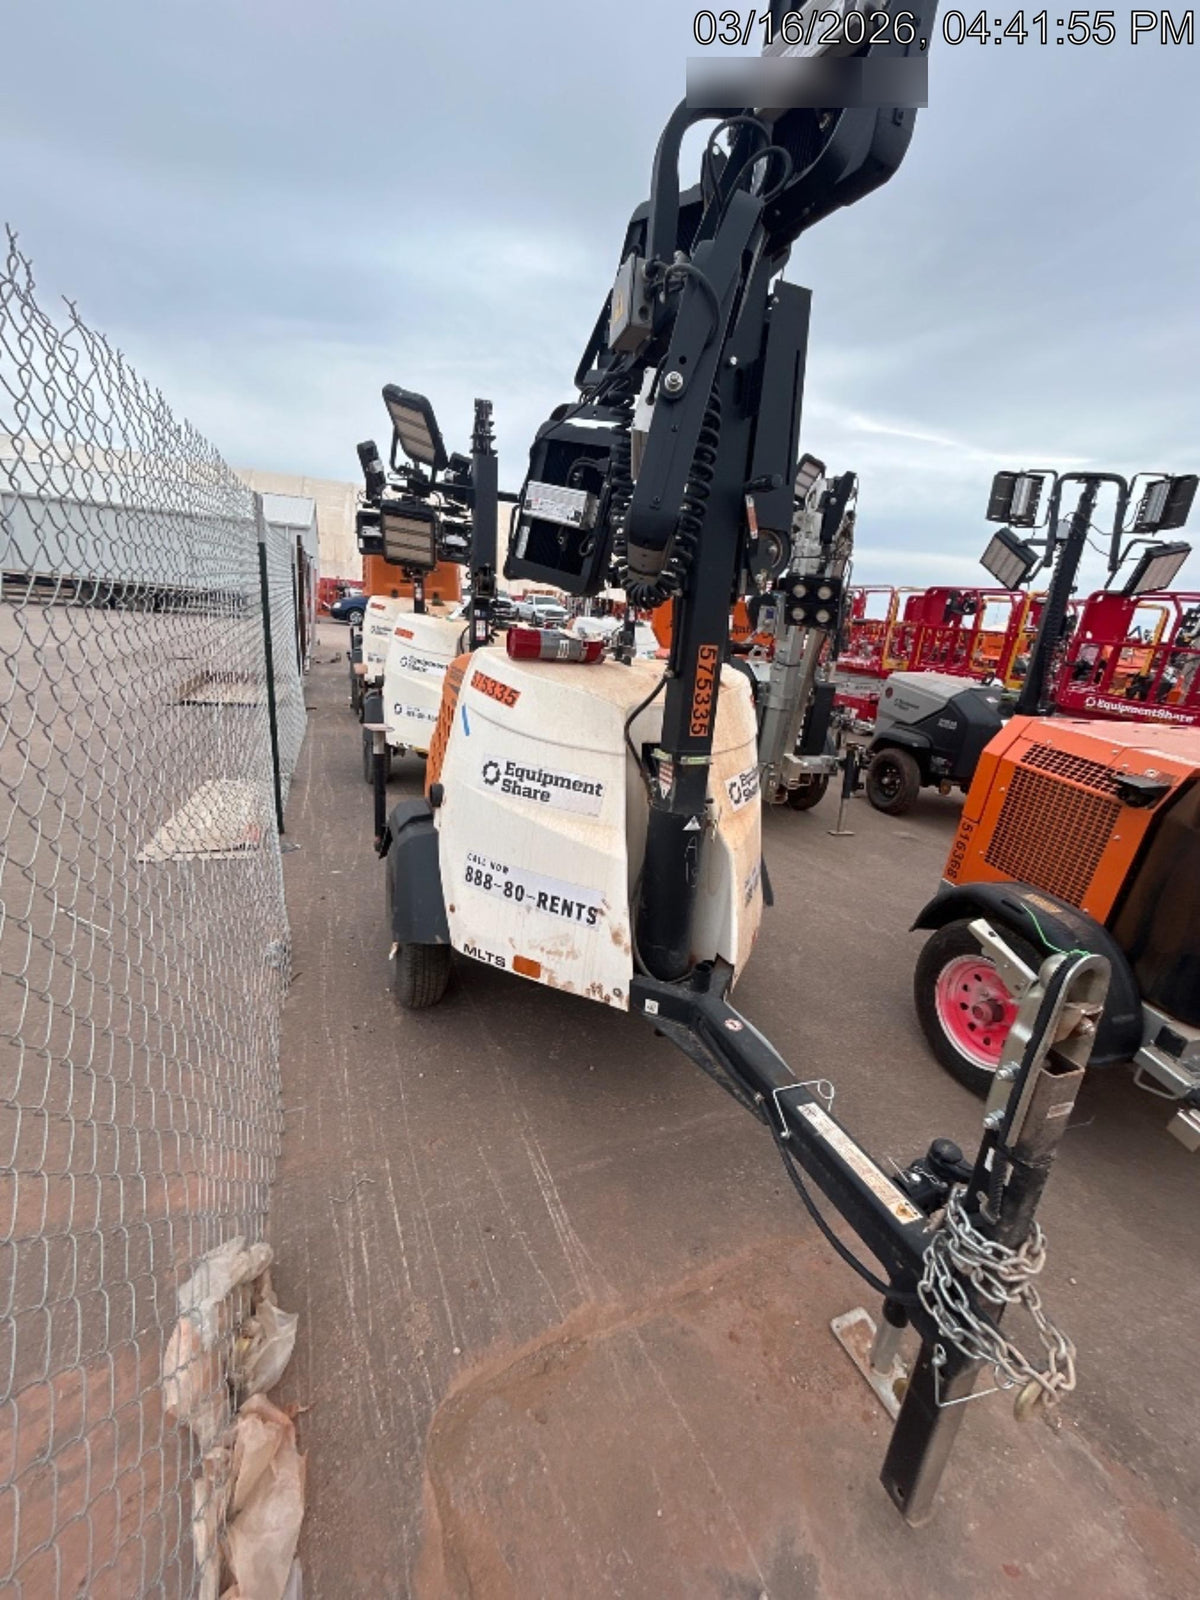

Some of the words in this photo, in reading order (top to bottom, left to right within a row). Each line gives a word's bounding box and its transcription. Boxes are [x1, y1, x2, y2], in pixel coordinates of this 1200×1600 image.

[691, 647, 717, 735] 575335
[501, 778, 551, 802] Share
[504, 761, 603, 797] Equipment
[467, 853, 487, 866] CALL
[490, 861, 510, 874] NOW
[465, 865, 599, 925] 888-80-RENTS
[463, 943, 506, 968] MLTS
